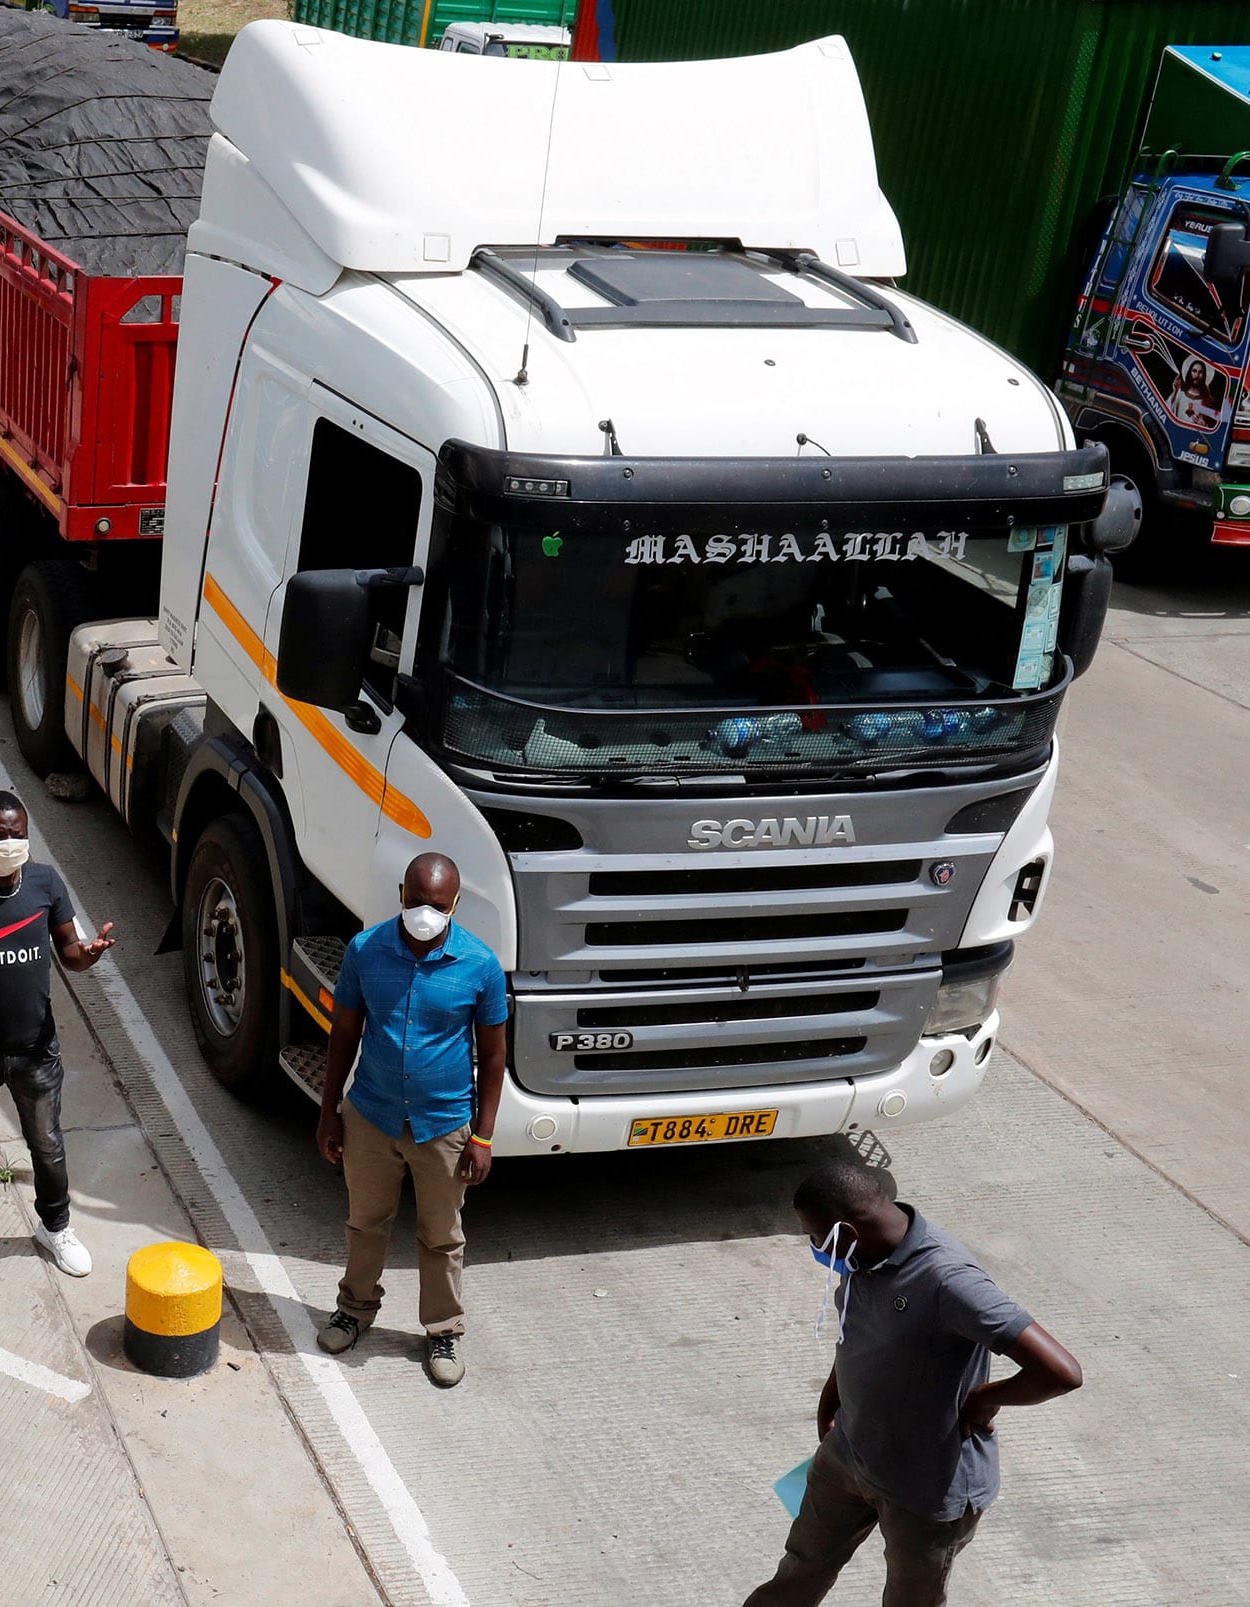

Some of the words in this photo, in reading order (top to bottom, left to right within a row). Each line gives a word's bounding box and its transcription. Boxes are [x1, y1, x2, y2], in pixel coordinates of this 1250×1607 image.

[1130, 366, 1167, 425] BETHANIA
[624, 530, 970, 565] MASHAALLAH
[687, 815, 857, 850] SCANIA
[724, 1113, 771, 1136] DRE
